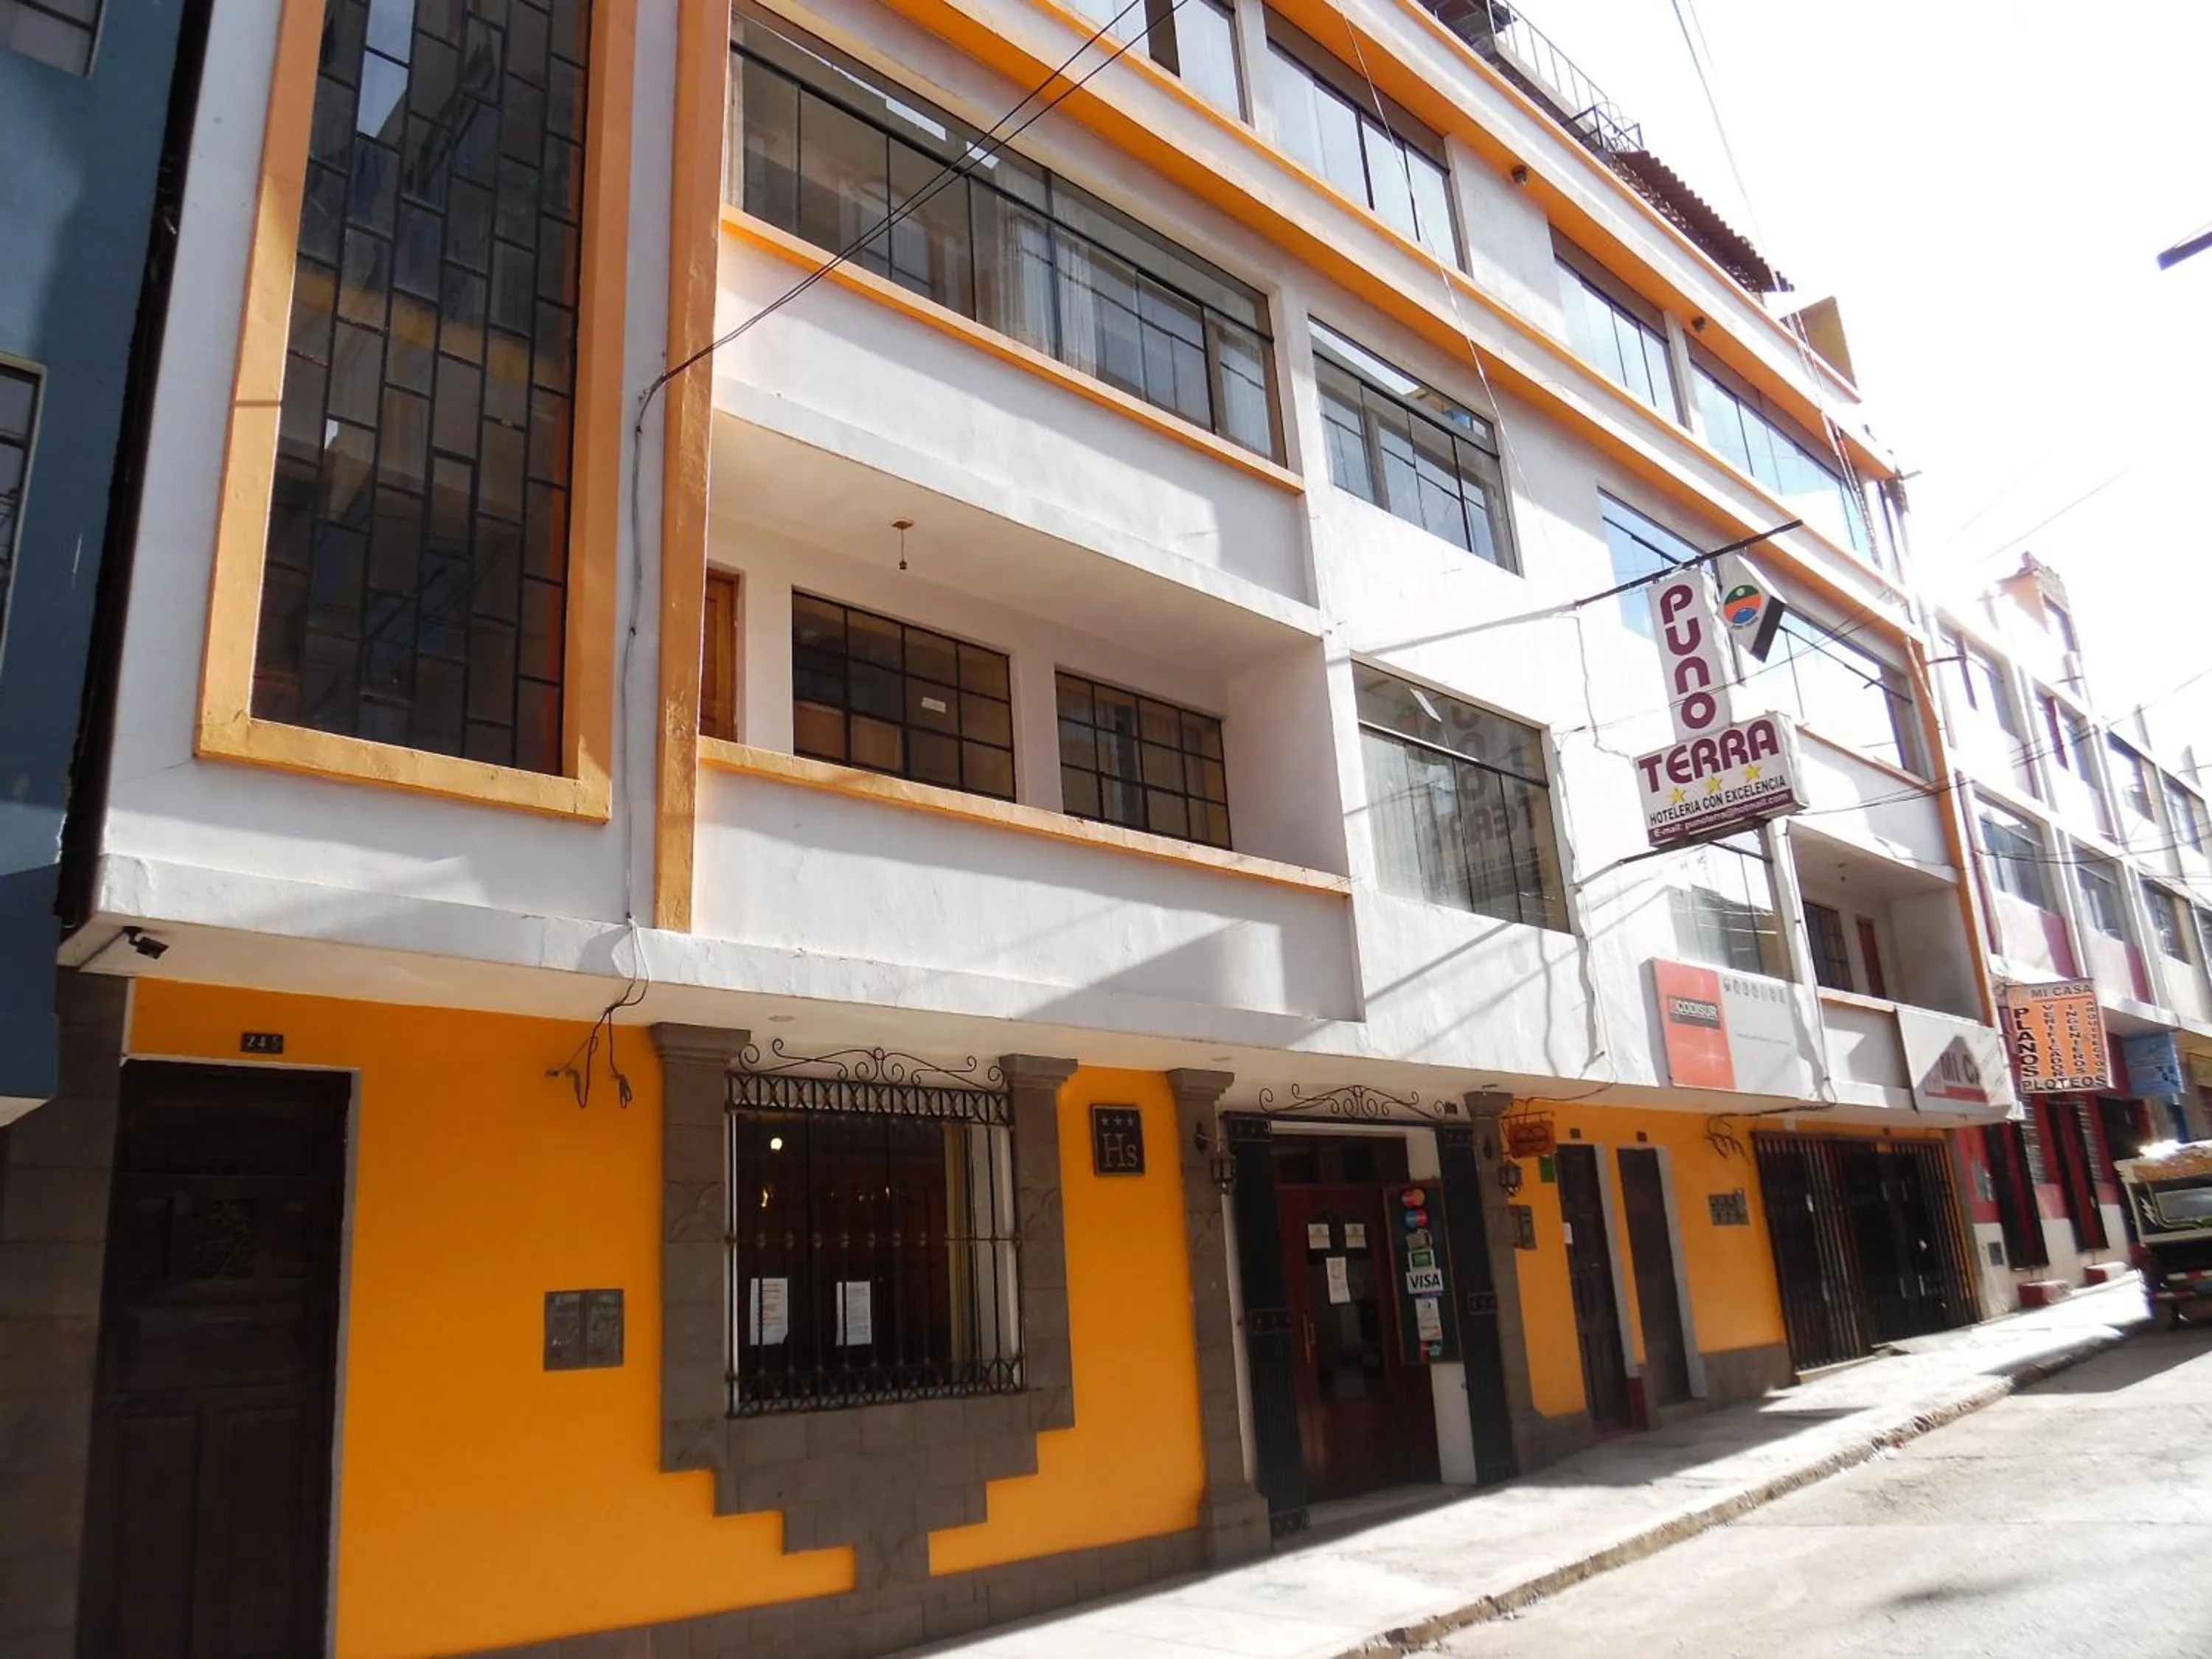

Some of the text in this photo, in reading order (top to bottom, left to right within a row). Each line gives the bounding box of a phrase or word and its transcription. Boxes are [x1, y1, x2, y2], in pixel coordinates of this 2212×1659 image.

[1660, 584, 1716, 729] PUNO
[1638, 719, 1780, 793] TERRA
[1649, 774, 1787, 825] HOTELERIA CON EXCELENCIA
[2031, 984, 2094, 998] MI CASA
[2014, 1008, 2039, 1077] PLANOS
[2021, 1075, 2107, 1091] PLOTEOS
[1409, 1273, 1441, 1289] VISA
